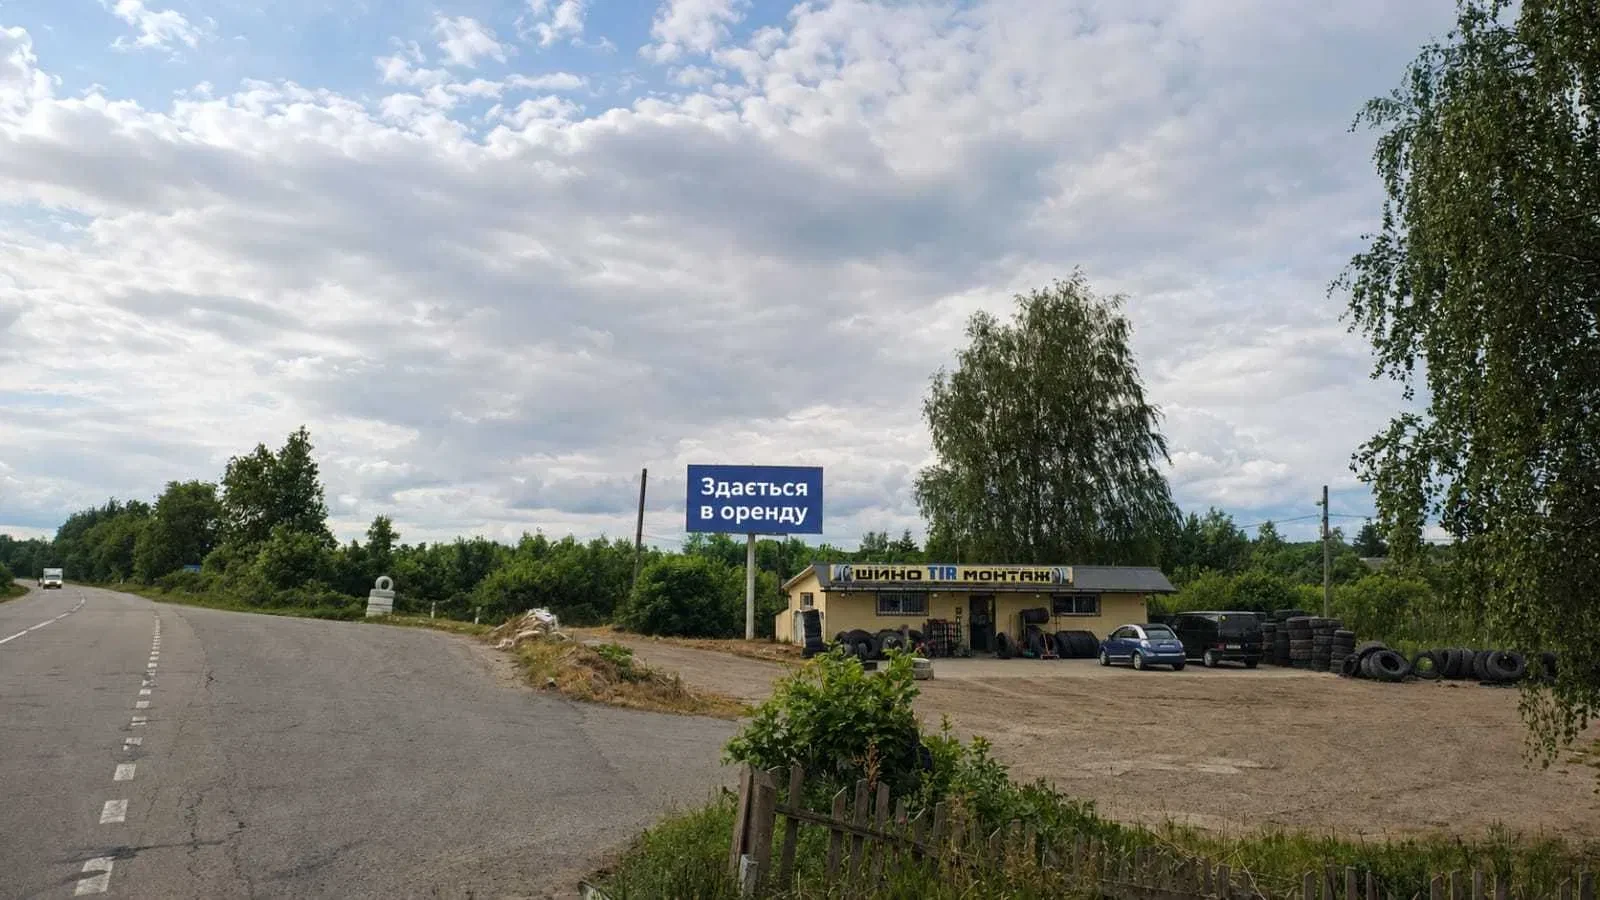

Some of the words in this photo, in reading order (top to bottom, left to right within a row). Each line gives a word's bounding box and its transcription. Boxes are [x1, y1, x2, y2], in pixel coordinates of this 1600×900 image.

[701, 477, 808, 499] Здається
[700, 505, 714, 519] в
[720, 505, 808, 526] оренду
[855, 569, 922, 580] ШИНО
[927, 565, 957, 580] TIR
[963, 570, 1051, 582] МОНТАЖ
